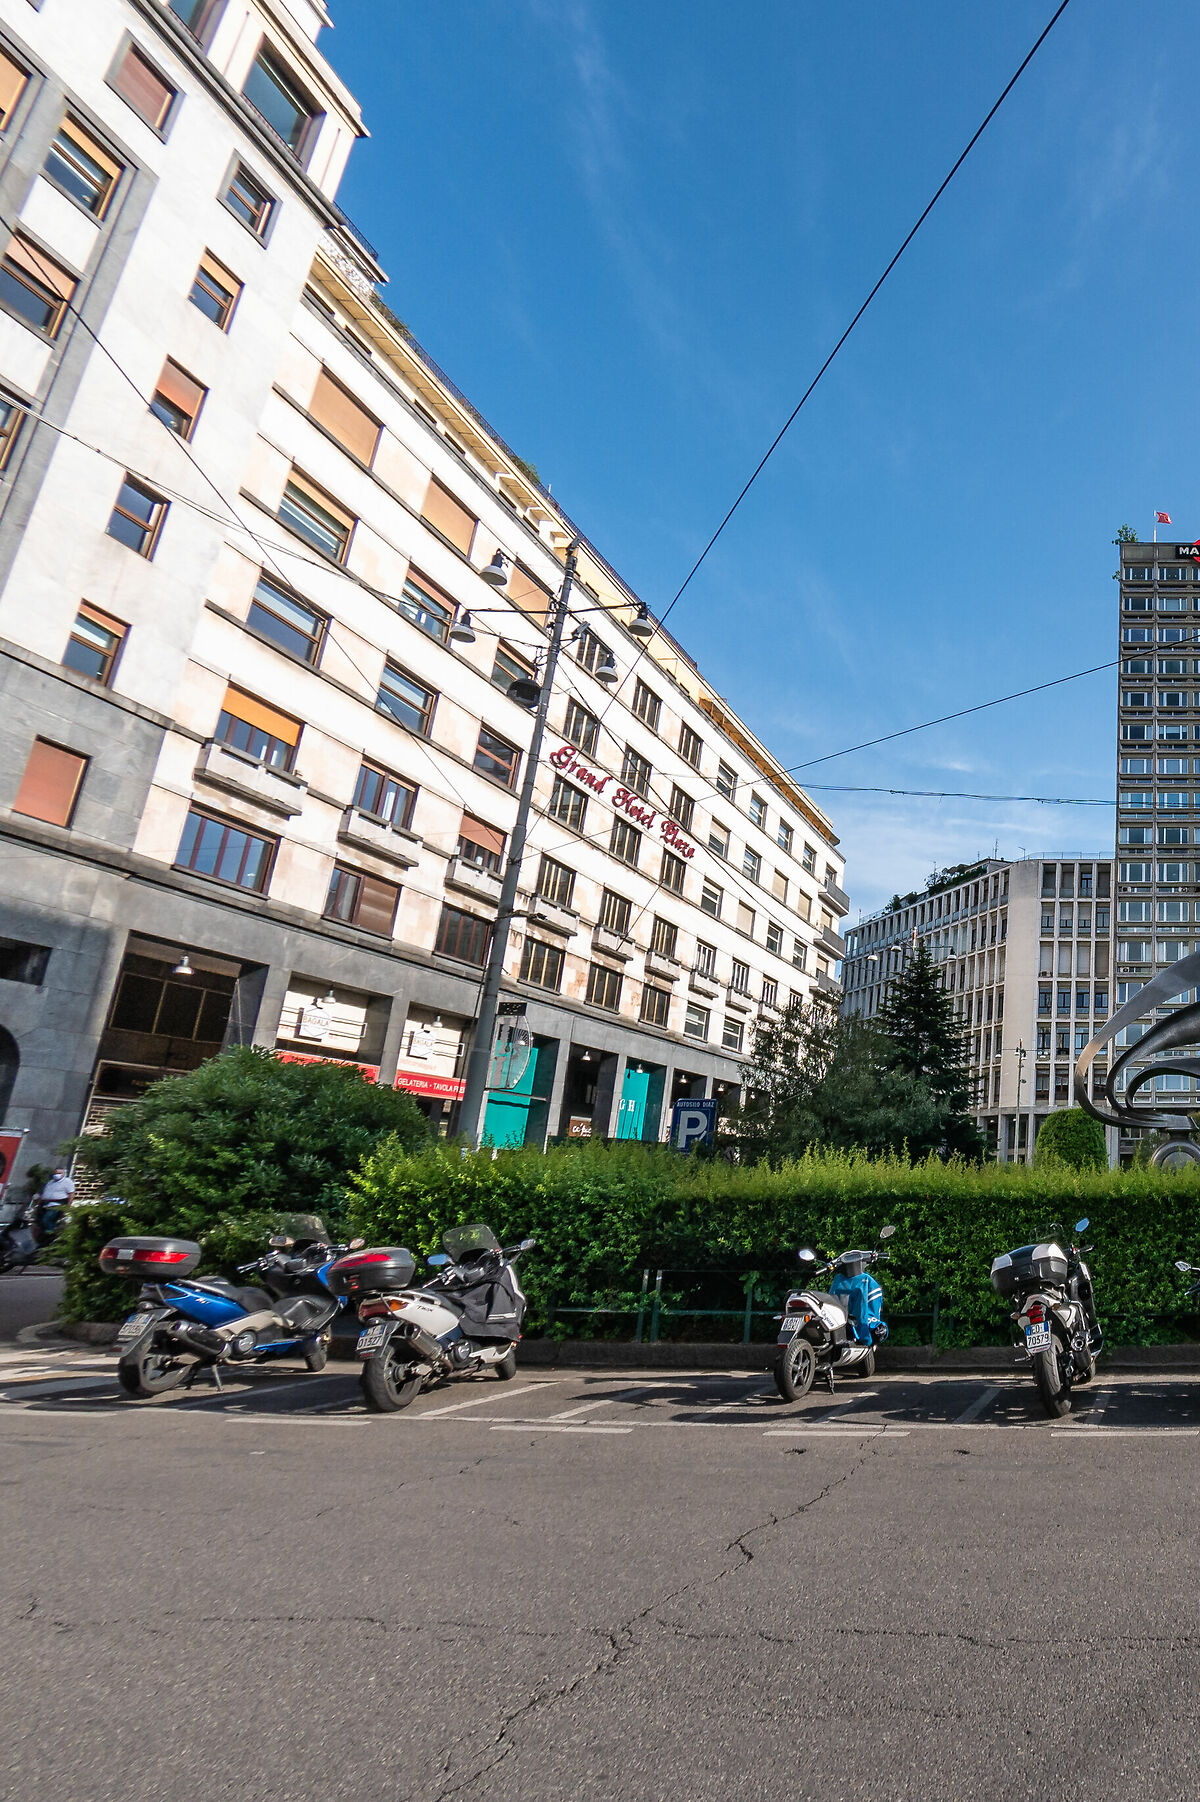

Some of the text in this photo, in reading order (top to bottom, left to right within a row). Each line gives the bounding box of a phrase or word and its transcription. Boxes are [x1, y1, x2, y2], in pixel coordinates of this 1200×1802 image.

[550, 746, 695, 859] Grand Hotel Plaza
[398, 1078, 428, 1088] GELATERIA
[433, 1082, 453, 1092] TAVOLA
[677, 1110, 707, 1148] P
